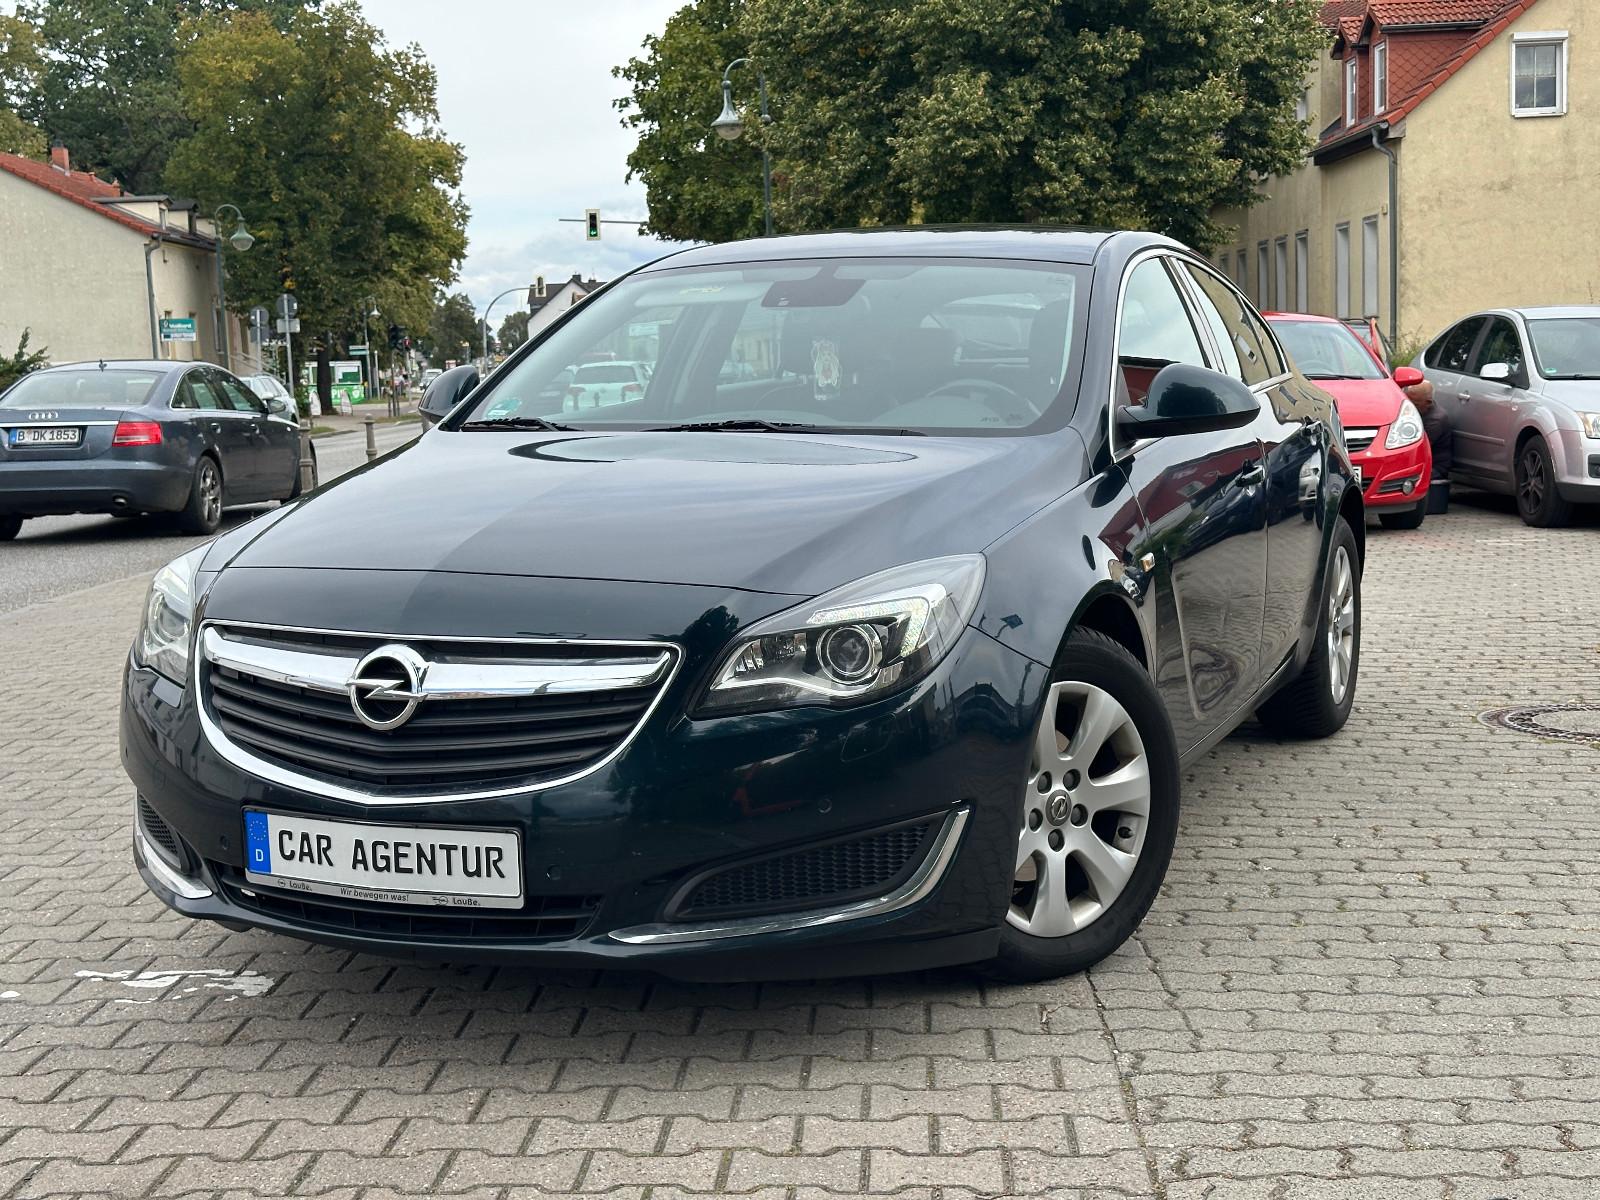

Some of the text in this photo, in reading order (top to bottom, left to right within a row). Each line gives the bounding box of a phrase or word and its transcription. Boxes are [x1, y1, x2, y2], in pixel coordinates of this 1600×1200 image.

[17, 430, 25, 441] B
[49, 430, 77, 441] 1853
[255, 848, 264, 862] D
[278, 829, 506, 879] CAR AGENTUR
[340, 887, 409, 902] Wir bewegen was!
